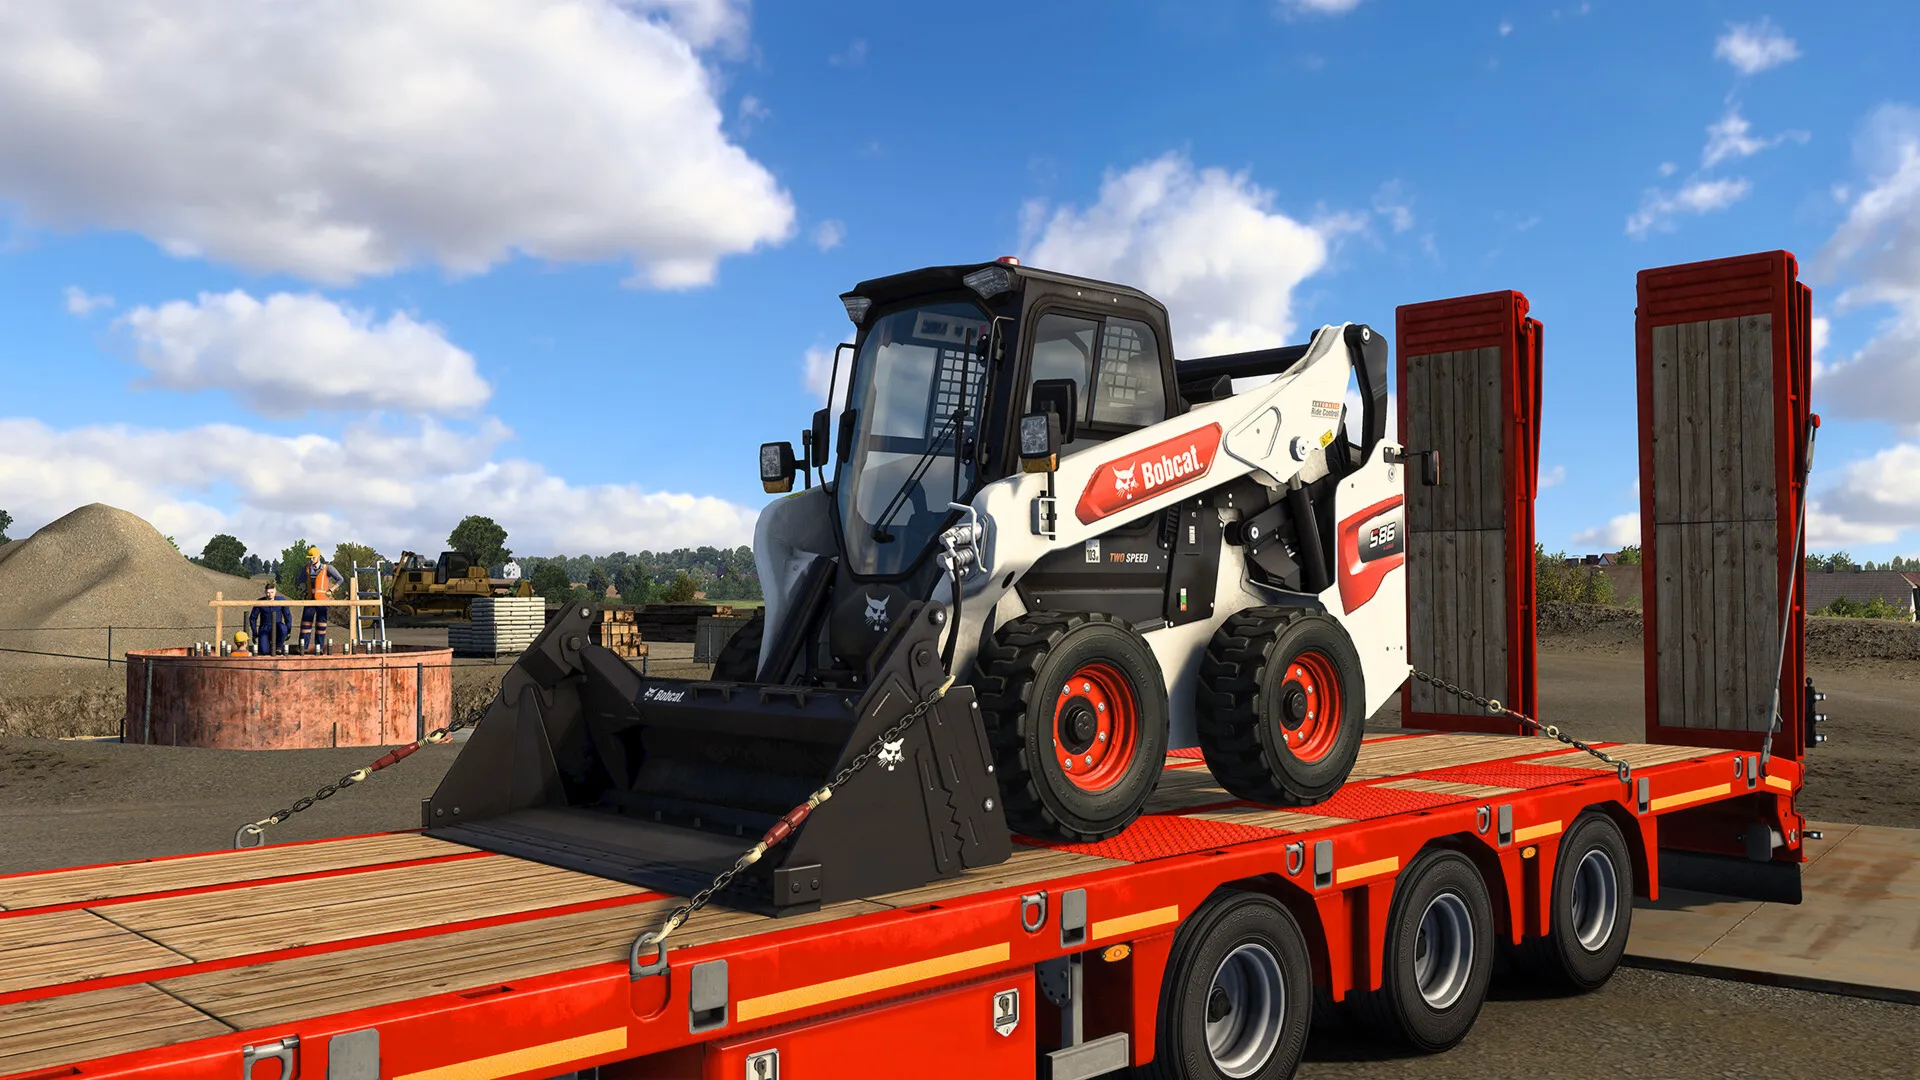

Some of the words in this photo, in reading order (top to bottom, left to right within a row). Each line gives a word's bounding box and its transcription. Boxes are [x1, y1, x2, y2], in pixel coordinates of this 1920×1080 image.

[1370, 522, 1396, 548] S86
[1109, 552, 1125, 563] TWO
[1126, 552, 1149, 563] SPEED
